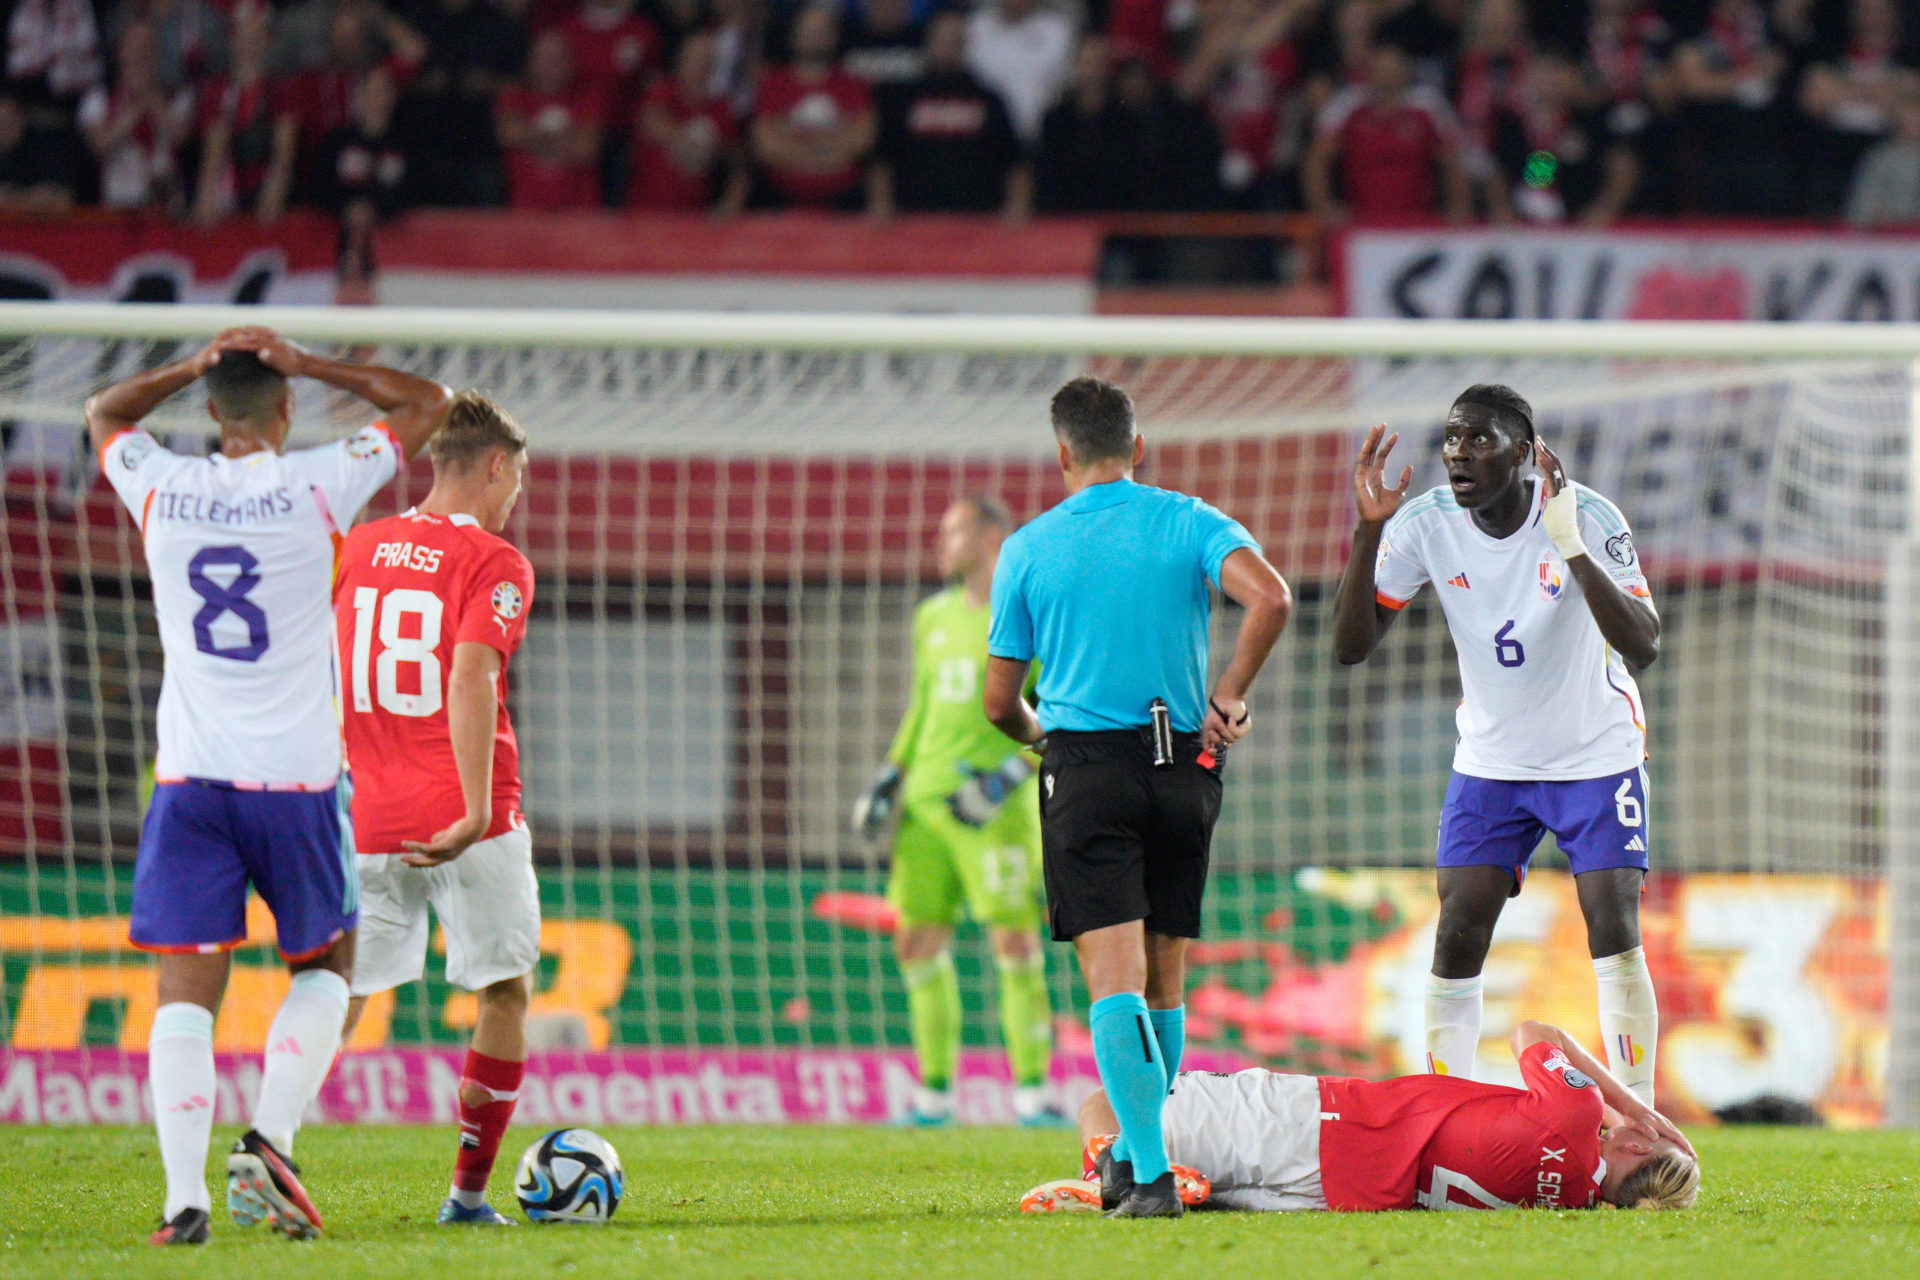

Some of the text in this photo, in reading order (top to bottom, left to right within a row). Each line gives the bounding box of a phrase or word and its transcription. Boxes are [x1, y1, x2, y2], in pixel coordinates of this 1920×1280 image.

[158, 486, 292, 525] TIELEMANS
[371, 542, 444, 573] PRASS
[188, 545, 270, 663] 8
[352, 585, 444, 718] 18
[1494, 619, 1526, 668] 6
[1614, 777, 1643, 828] 6
